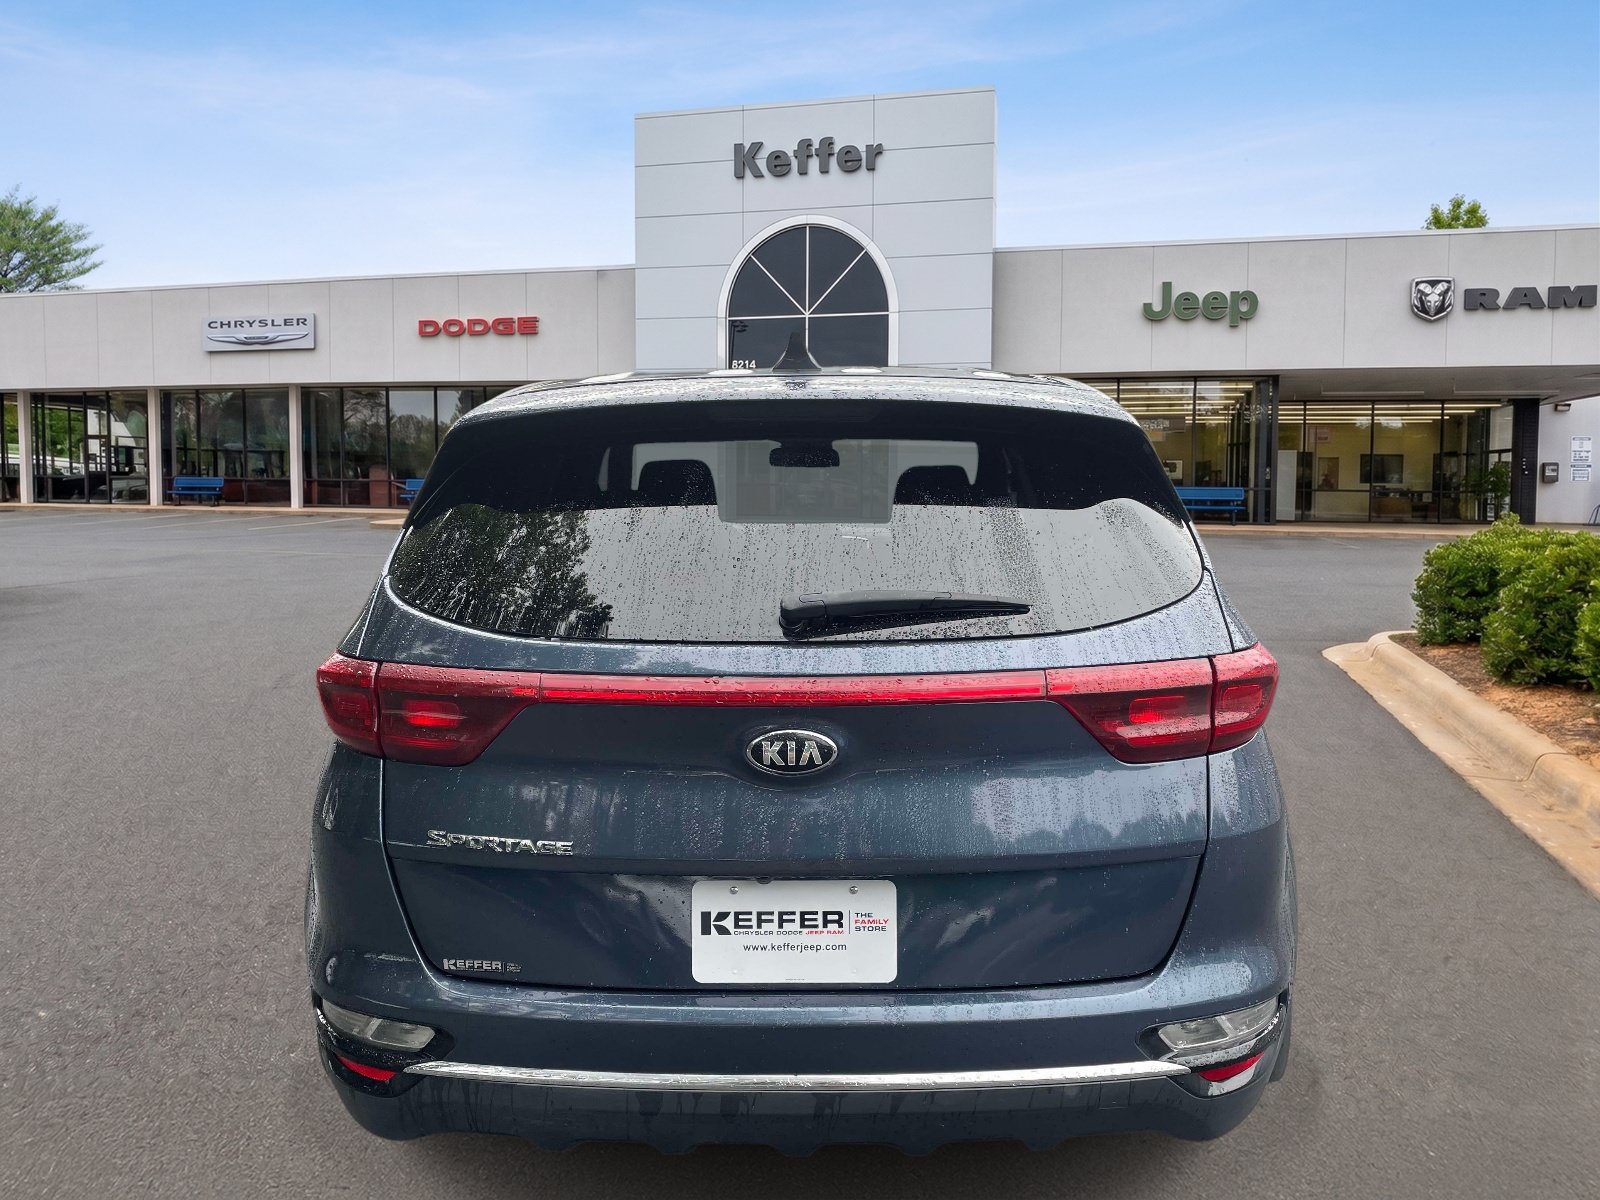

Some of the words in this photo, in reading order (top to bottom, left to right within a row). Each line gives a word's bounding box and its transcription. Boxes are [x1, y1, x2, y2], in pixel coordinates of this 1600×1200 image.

[733, 136, 883, 178] Keffer
[1143, 281, 1259, 327] Jeep
[1464, 284, 1598, 310] RAM
[207, 317, 308, 329] CHRYSLER
[418, 316, 539, 337] DODGE
[732, 360, 757, 369] 8214
[762, 740, 823, 766] KIA
[427, 829, 574, 856] SPORTAGE
[701, 911, 844, 935] KEFFER
[743, 943, 847, 953] www.kefferjeep.com
[443, 959, 502, 970] KEFFER
